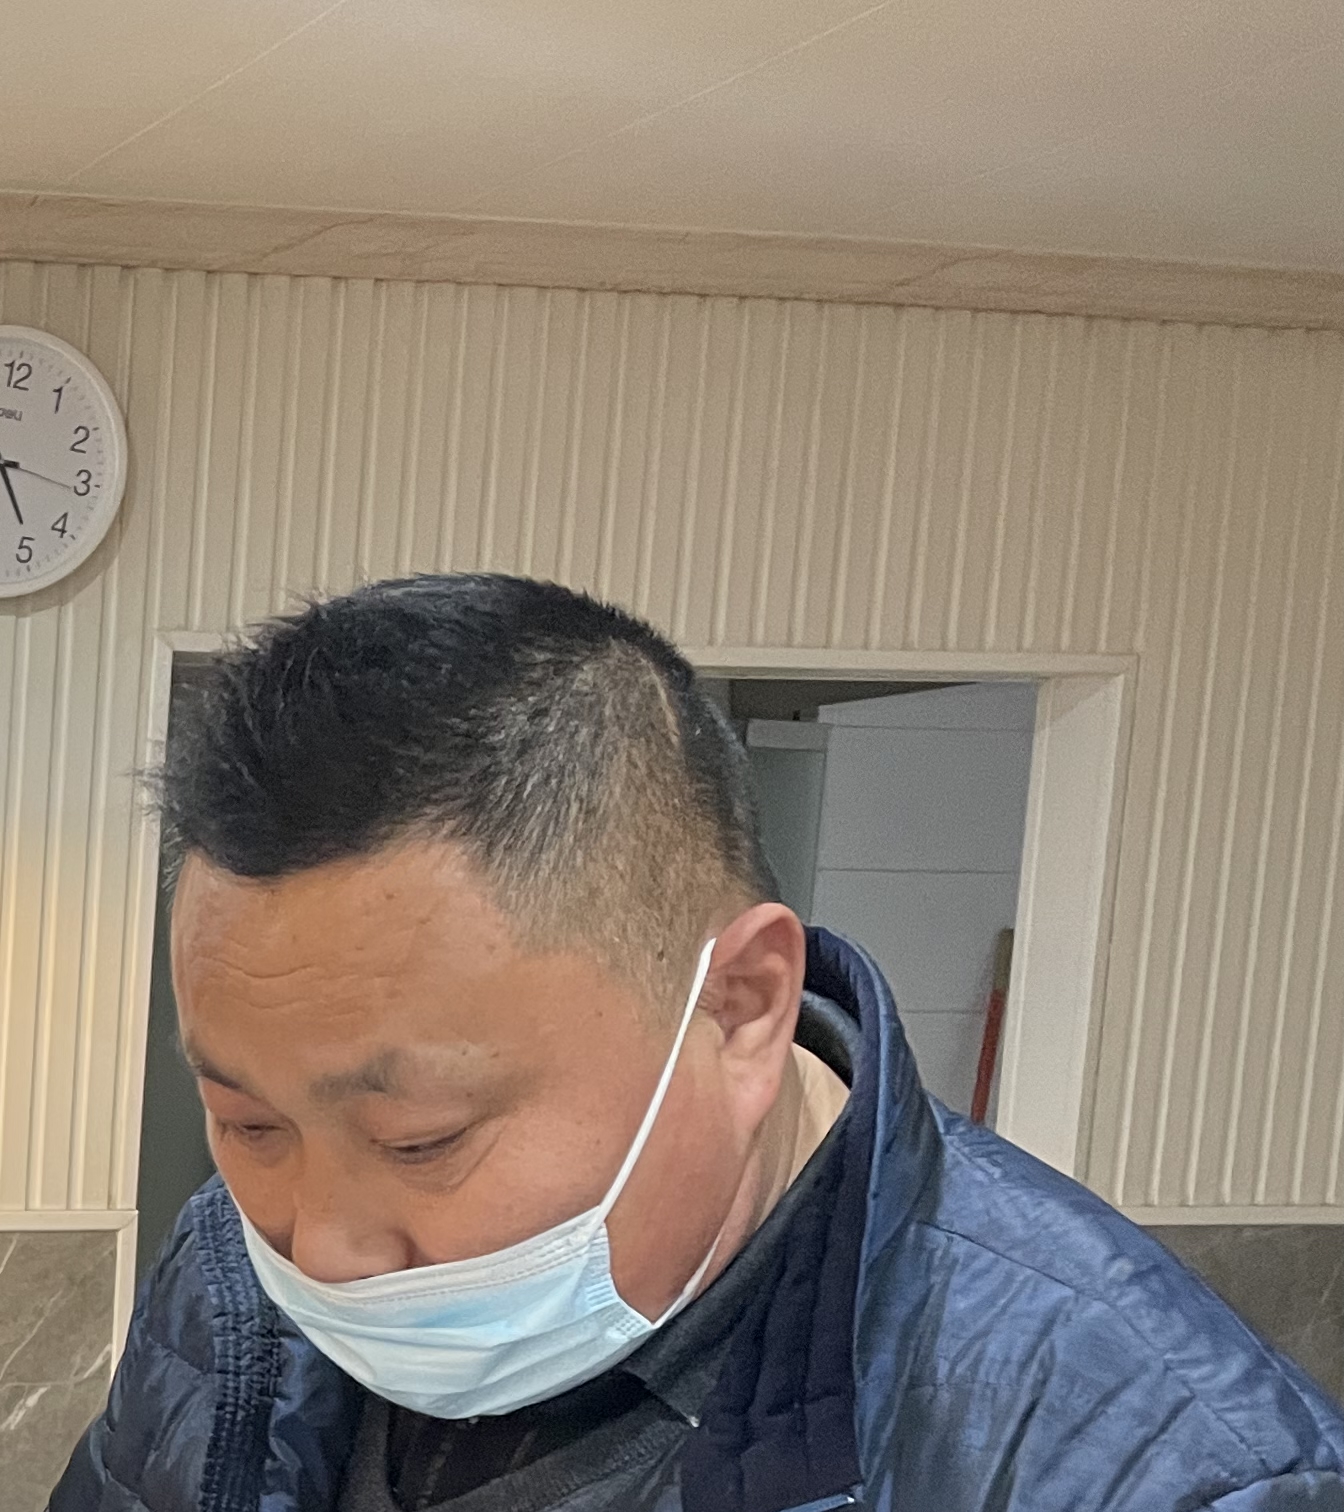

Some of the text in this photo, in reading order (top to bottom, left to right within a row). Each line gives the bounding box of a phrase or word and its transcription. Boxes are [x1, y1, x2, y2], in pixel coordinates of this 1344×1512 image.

[4, 360, 33, 391] 12
[53, 386, 63, 413] 1
[70, 425, 90, 453] 2
[73, 469, 92, 496] 3
[51, 512, 69, 538] 4
[15, 536, 35, 563] 5
